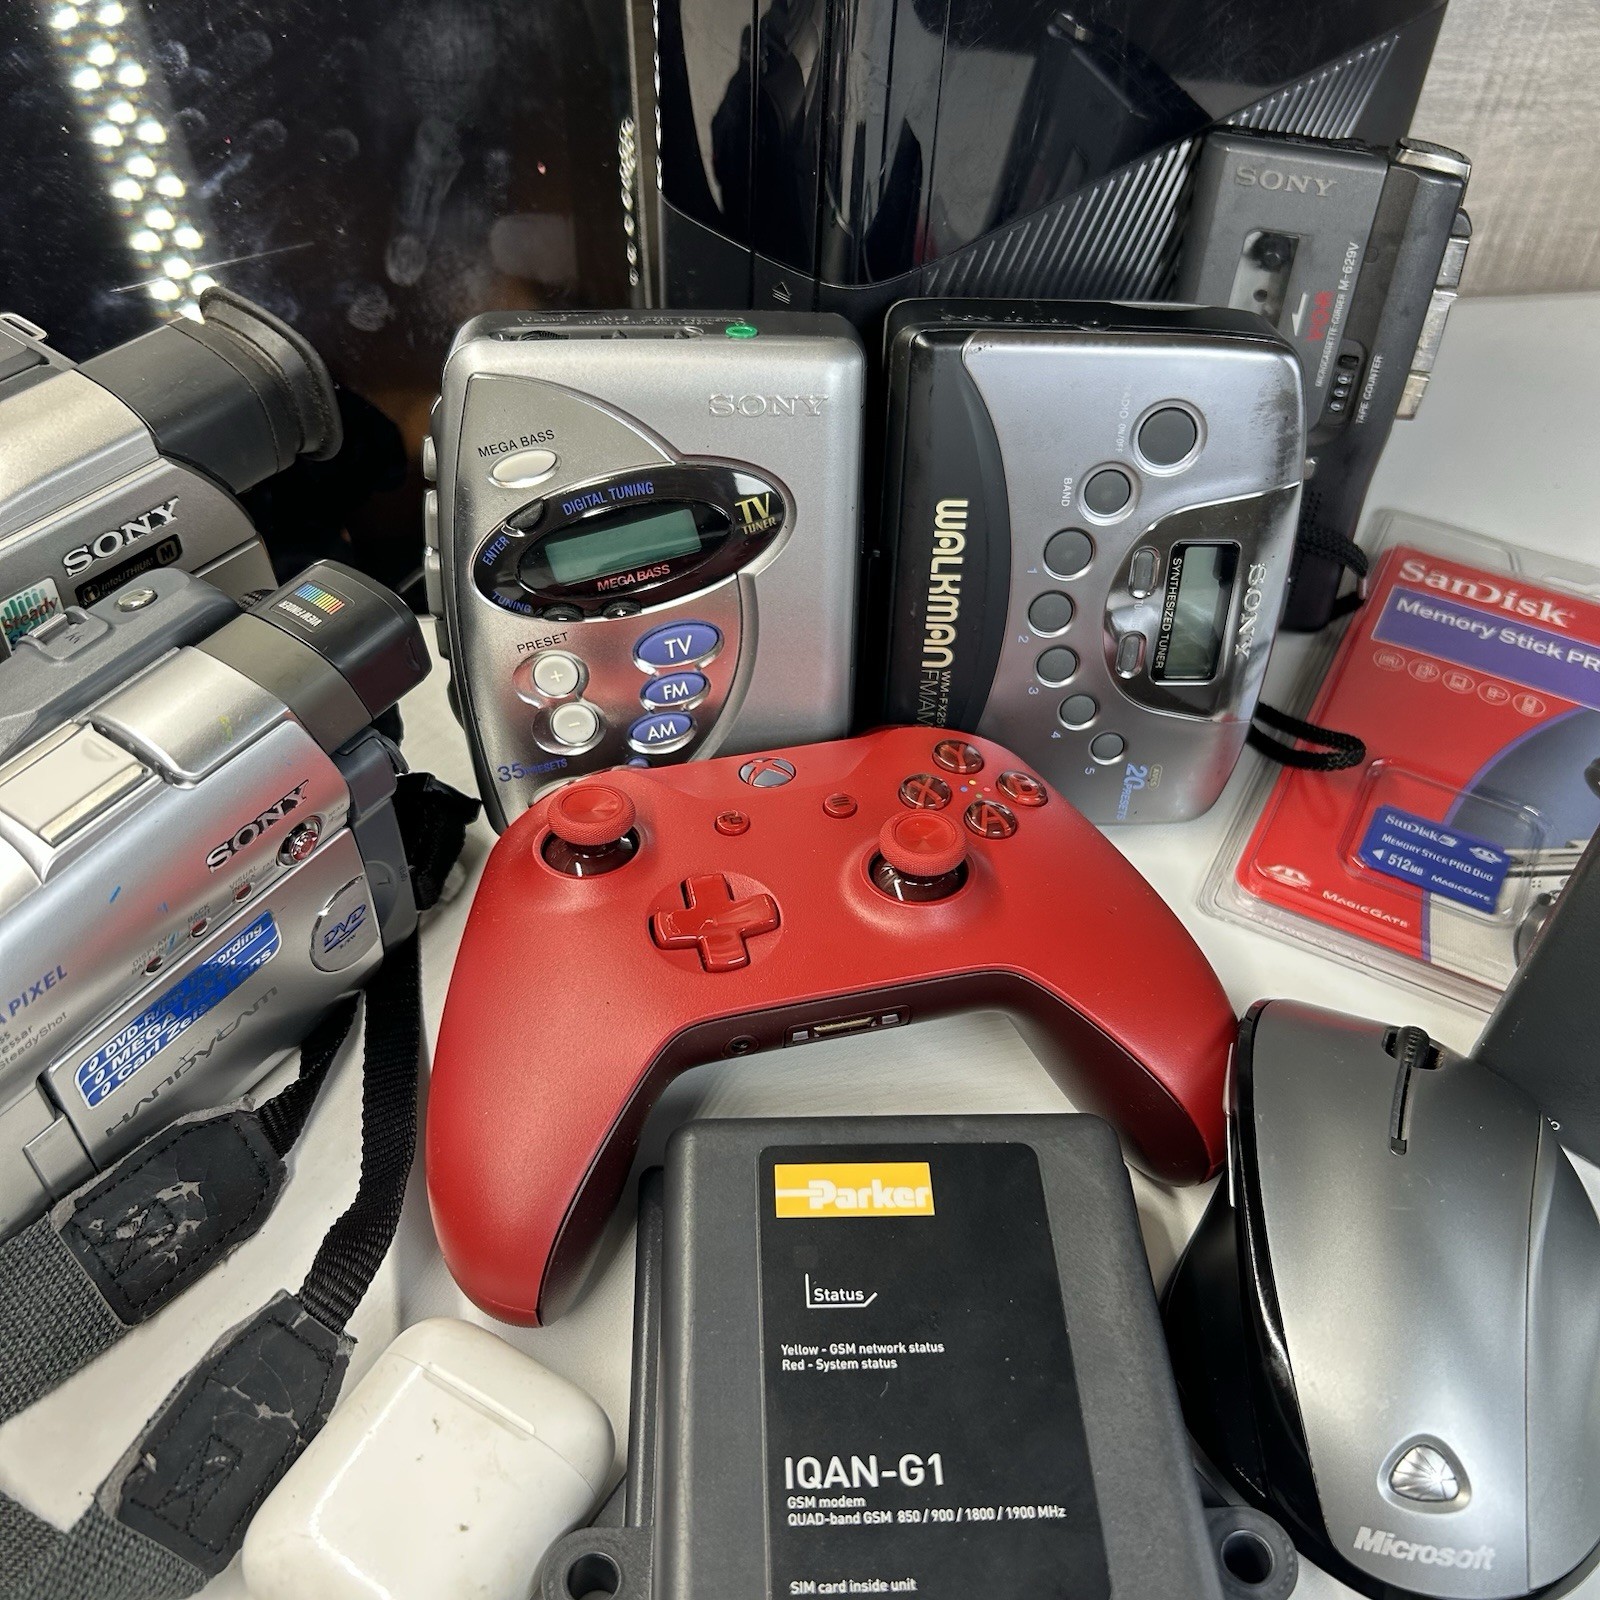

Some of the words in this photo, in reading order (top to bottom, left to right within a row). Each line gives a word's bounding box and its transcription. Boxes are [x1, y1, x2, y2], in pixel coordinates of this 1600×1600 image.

[1234, 165, 1337, 197] SONY
[1362, 354, 1385, 400] COUNTER
[708, 393, 829, 416] SONY
[478, 437, 517, 457] MEGA
[519, 428, 555, 449] BASS
[562, 491, 608, 516] DIGITAL
[608, 481, 655, 501] TUNING
[1061, 476, 1073, 507] BAND
[735, 493, 771, 524] TV
[62, 497, 179, 577] SONY
[741, 517, 777, 534] TUNER
[482, 535, 511, 567] ENTER
[597, 576, 636, 592] MEGA
[636, 563, 671, 583] BASS
[492, 591, 533, 614] TUNING
[1162, 557, 1183, 632] SYNTHESIZED
[1399, 559, 1570, 628] SanDisk
[1234, 563, 1267, 659] SONY
[517, 631, 568, 653] PRESET
[1018, 635, 1029, 644] 2
[1396, 597, 1497, 640] Memory
[1499, 627, 1564, 661] Stick
[663, 633, 693, 660] TV
[1154, 634, 1171, 669] TUNER
[663, 681, 690, 701] FM
[936, 670, 951, 728] WM-FX25
[1028, 686, 1040, 695] 3
[647, 721, 677, 740] AM
[1050, 730, 1061, 739] 4
[497, 763, 525, 783] 35
[1085, 767, 1096, 776] 5
[1124, 763, 1149, 790] 20
[206, 779, 310, 873] SONY
[1385, 814, 1439, 842] SanDisk
[1387, 852, 1425, 877] 512MB
[1449, 859, 1473, 875] PRO
[324, 903, 367, 950] DVD
[8, 965, 68, 1018] PIXEL
[111, 1012, 177, 1071] MEGA
[118, 1039, 162, 1083] Carl
[807, 1178, 931, 1210] Parker
[813, 1287, 865, 1302] Status
[781, 1343, 819, 1356] Yellow
[829, 1342, 857, 1355] GSM
[858, 1341, 907, 1354] network
[908, 1341, 945, 1354] status
[782, 1358, 806, 1371] Red
[815, 1358, 859, 1373] System
[861, 1358, 898, 1370] status
[784, 1452, 945, 1490] IQAN-G1
[787, 1495, 817, 1509] GSM
[818, 1495, 867, 1508] modem
[788, 1510, 861, 1527] QUAD-band
[862, 1510, 893, 1525] GSM
[897, 1509, 921, 1524] 850
[931, 1508, 954, 1523] 900
[965, 1507, 995, 1522] 1800
[1006, 1505, 1037, 1520] 1900
[1038, 1504, 1067, 1519] MHz
[1354, 1525, 1496, 1571] Microsoft
[789, 1580, 816, 1595] SIM
[818, 1579, 847, 1594] card
[849, 1578, 888, 1593] inside
[890, 1577, 918, 1592] unit
